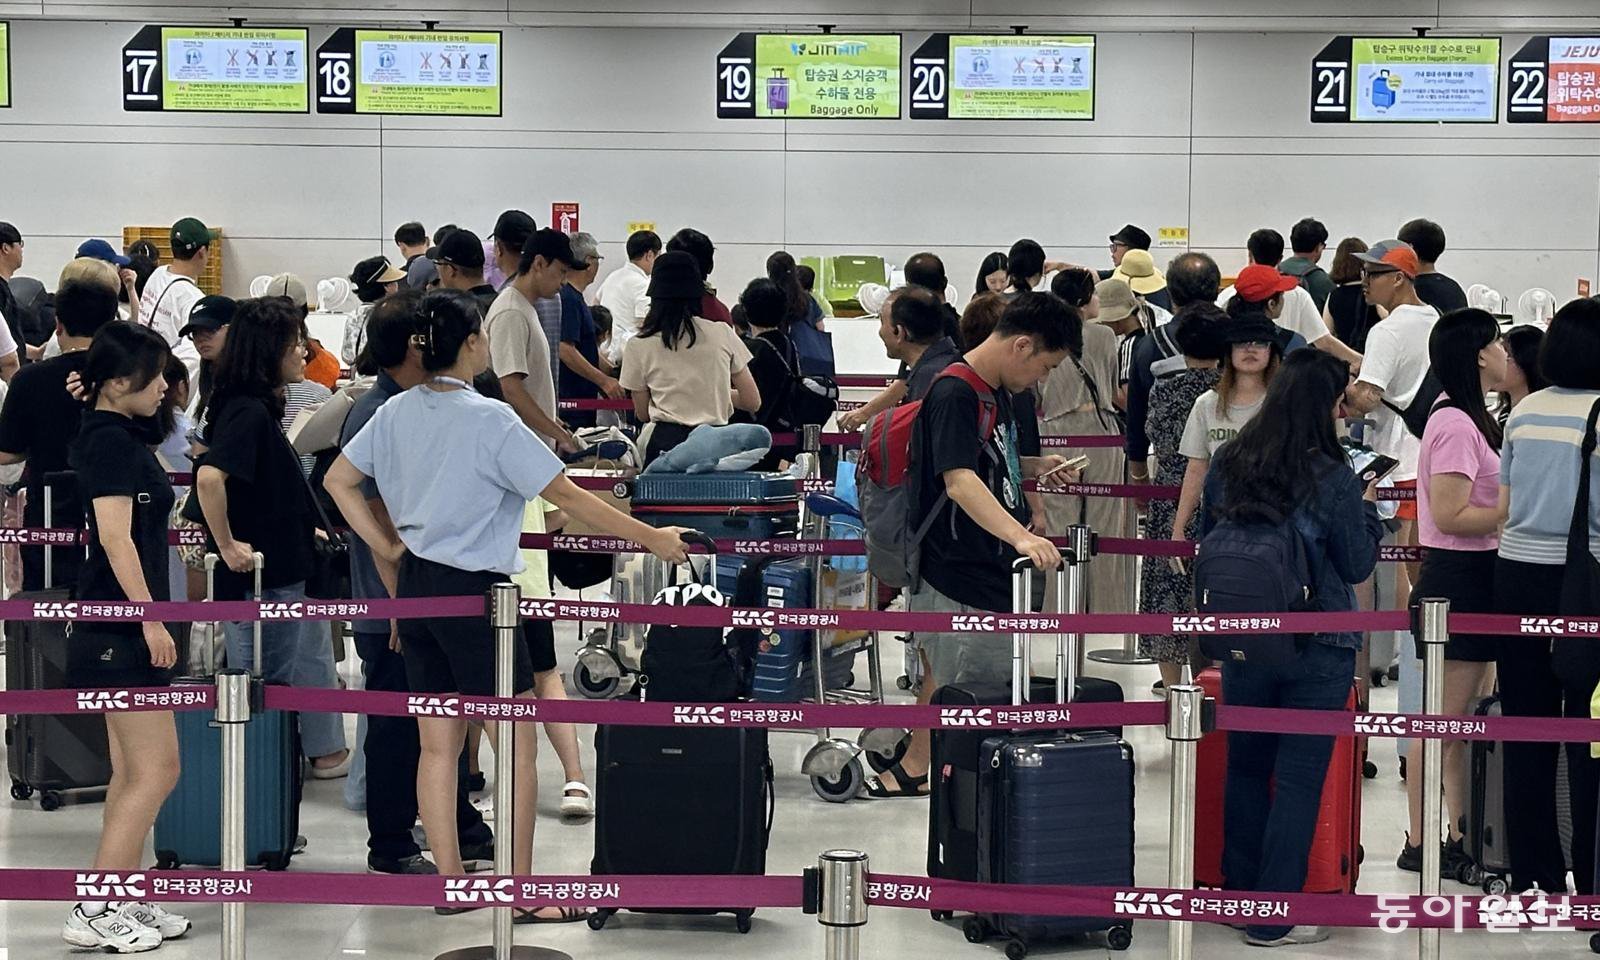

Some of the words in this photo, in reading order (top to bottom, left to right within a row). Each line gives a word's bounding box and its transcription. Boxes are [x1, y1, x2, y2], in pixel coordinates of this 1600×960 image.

[126, 58, 157, 92] 17
[320, 60, 351, 95] 18
[720, 65, 751, 100] 19
[804, 69, 839, 82] 탑승권
[842, 69, 888, 83] 소지승객
[912, 66, 945, 101] 20
[1557, 71, 1595, 86] 탑승권
[816, 87, 850, 100] 수하물
[853, 87, 877, 100] 전용
[1317, 70, 1345, 104] 21
[1511, 70, 1545, 104] 22
[810, 105, 853, 116] Baggage
[856, 105, 879, 116] Only
[1556, 104, 1592, 115] Baggage
[1378, 490, 1418, 499] 한국공항공
[553, 536, 589, 550] KAC
[735, 541, 770, 553] KAC
[774, 543, 824, 552] 한국공항공사
[33, 603, 77, 617] KAC
[82, 605, 145, 616] 한국공항공사
[259, 602, 303, 618] KAC
[306, 604, 369, 616] 한국공항공사
[559, 606, 620, 618] 한국공항공사
[732, 610, 775, 626] KAC
[778, 614, 839, 626] 한국공항공사
[952, 615, 995, 631] KAC
[998, 619, 1060, 630] 한국공항공사
[1172, 616, 1216, 632] KAC
[1219, 618, 1281, 629] 한국공항공사
[1520, 617, 1565, 634] KAC
[77, 691, 130, 709] KAC
[133, 691, 207, 706] 한국공항공사
[407, 697, 459, 716] KAC
[463, 702, 537, 717] 한국공항공사
[673, 706, 725, 724] KAC
[729, 709, 804, 722] 한국공항공사
[940, 708, 992, 726] KAC
[996, 710, 1071, 724] 한국공항공사
[1354, 716, 1406, 734] KAC
[1411, 720, 1486, 734] 한국공항공사
[75, 873, 146, 897] KAC
[152, 877, 253, 896] 한국공항공사
[444, 879, 515, 902] KAC
[521, 882, 620, 900] 한국공항공사
[1113, 891, 1183, 917] KAC
[1190, 897, 1290, 918] 한국공항공사
